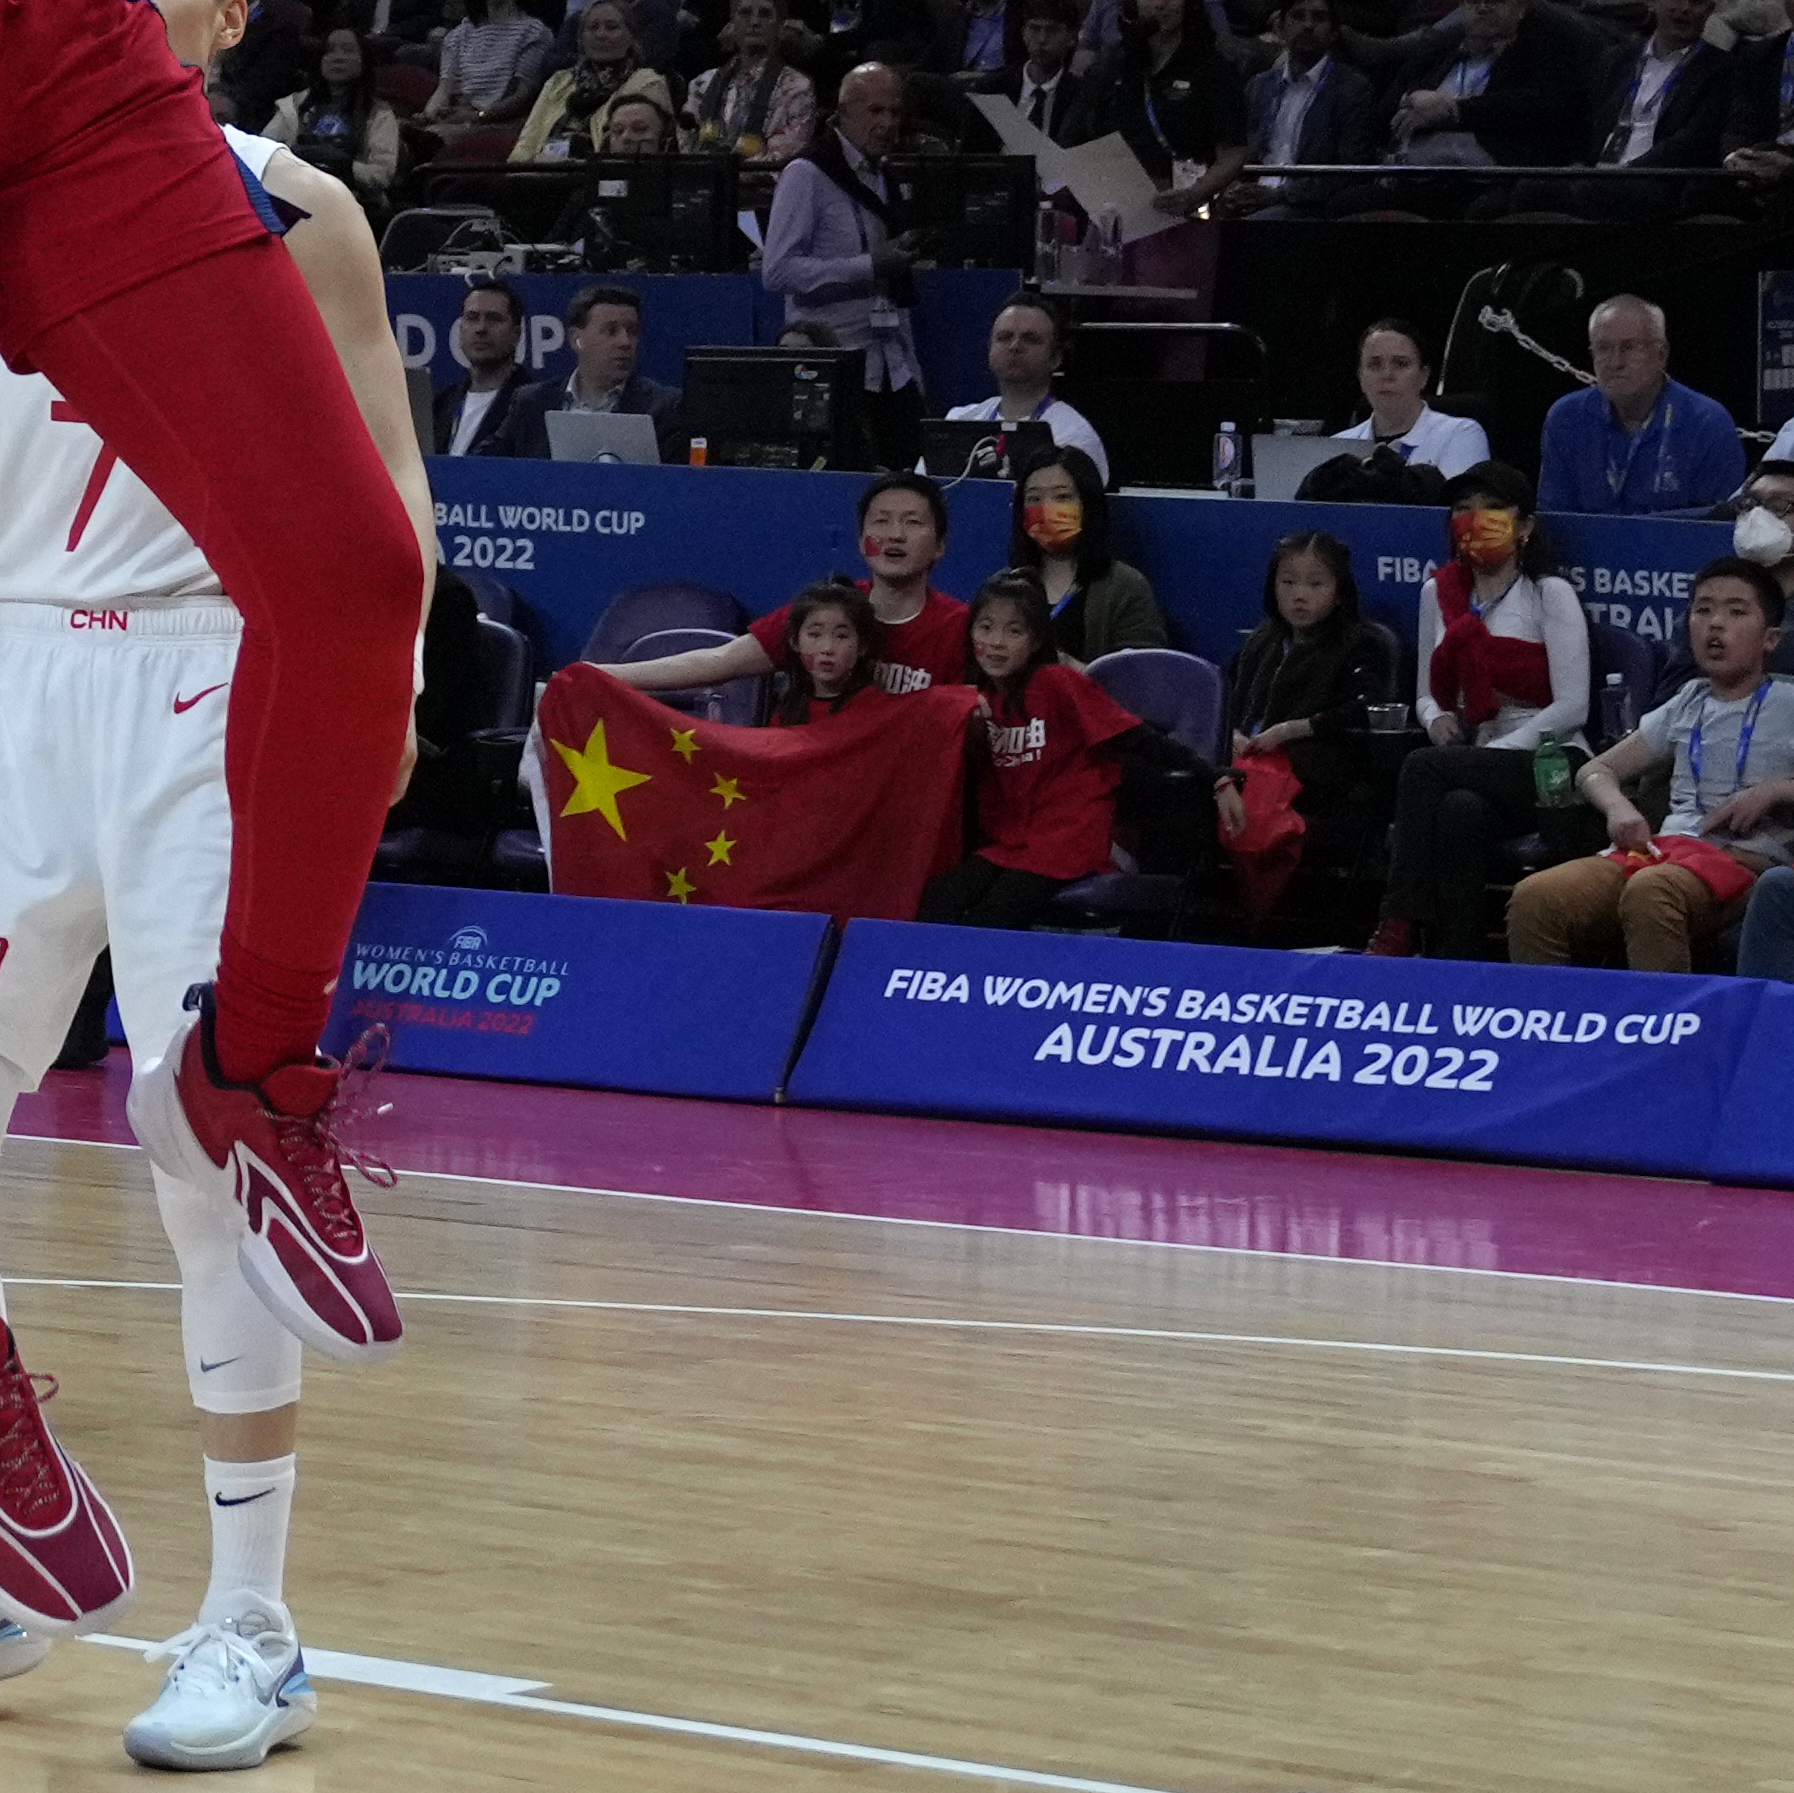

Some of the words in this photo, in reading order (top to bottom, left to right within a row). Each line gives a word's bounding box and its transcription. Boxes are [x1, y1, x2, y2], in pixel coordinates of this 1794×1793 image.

[50, 400, 120, 553] 7
[498, 506, 590, 534] WORLD
[594, 509, 646, 535] CUP
[452, 534, 536, 570] 2022
[69, 608, 128, 632] CHN
[356, 943, 445, 966] WOMEN'S
[448, 951, 570, 977] BASKETBALL
[352, 960, 481, 1001] WORLD
[485, 972, 562, 1008] CUP
[476, 1010, 536, 1035] 2022
[883, 968, 971, 1004] FIBA
[982, 975, 1172, 1018] WOMEN'S
[1174, 988, 1440, 1035] BASKETBALL
[1451, 1003, 1608, 1044] WORLD
[1613, 1011, 1703, 1046] CUP
[1033, 1021, 1343, 1083] AUSTRALIA
[1352, 1042, 1501, 1092] 2022
